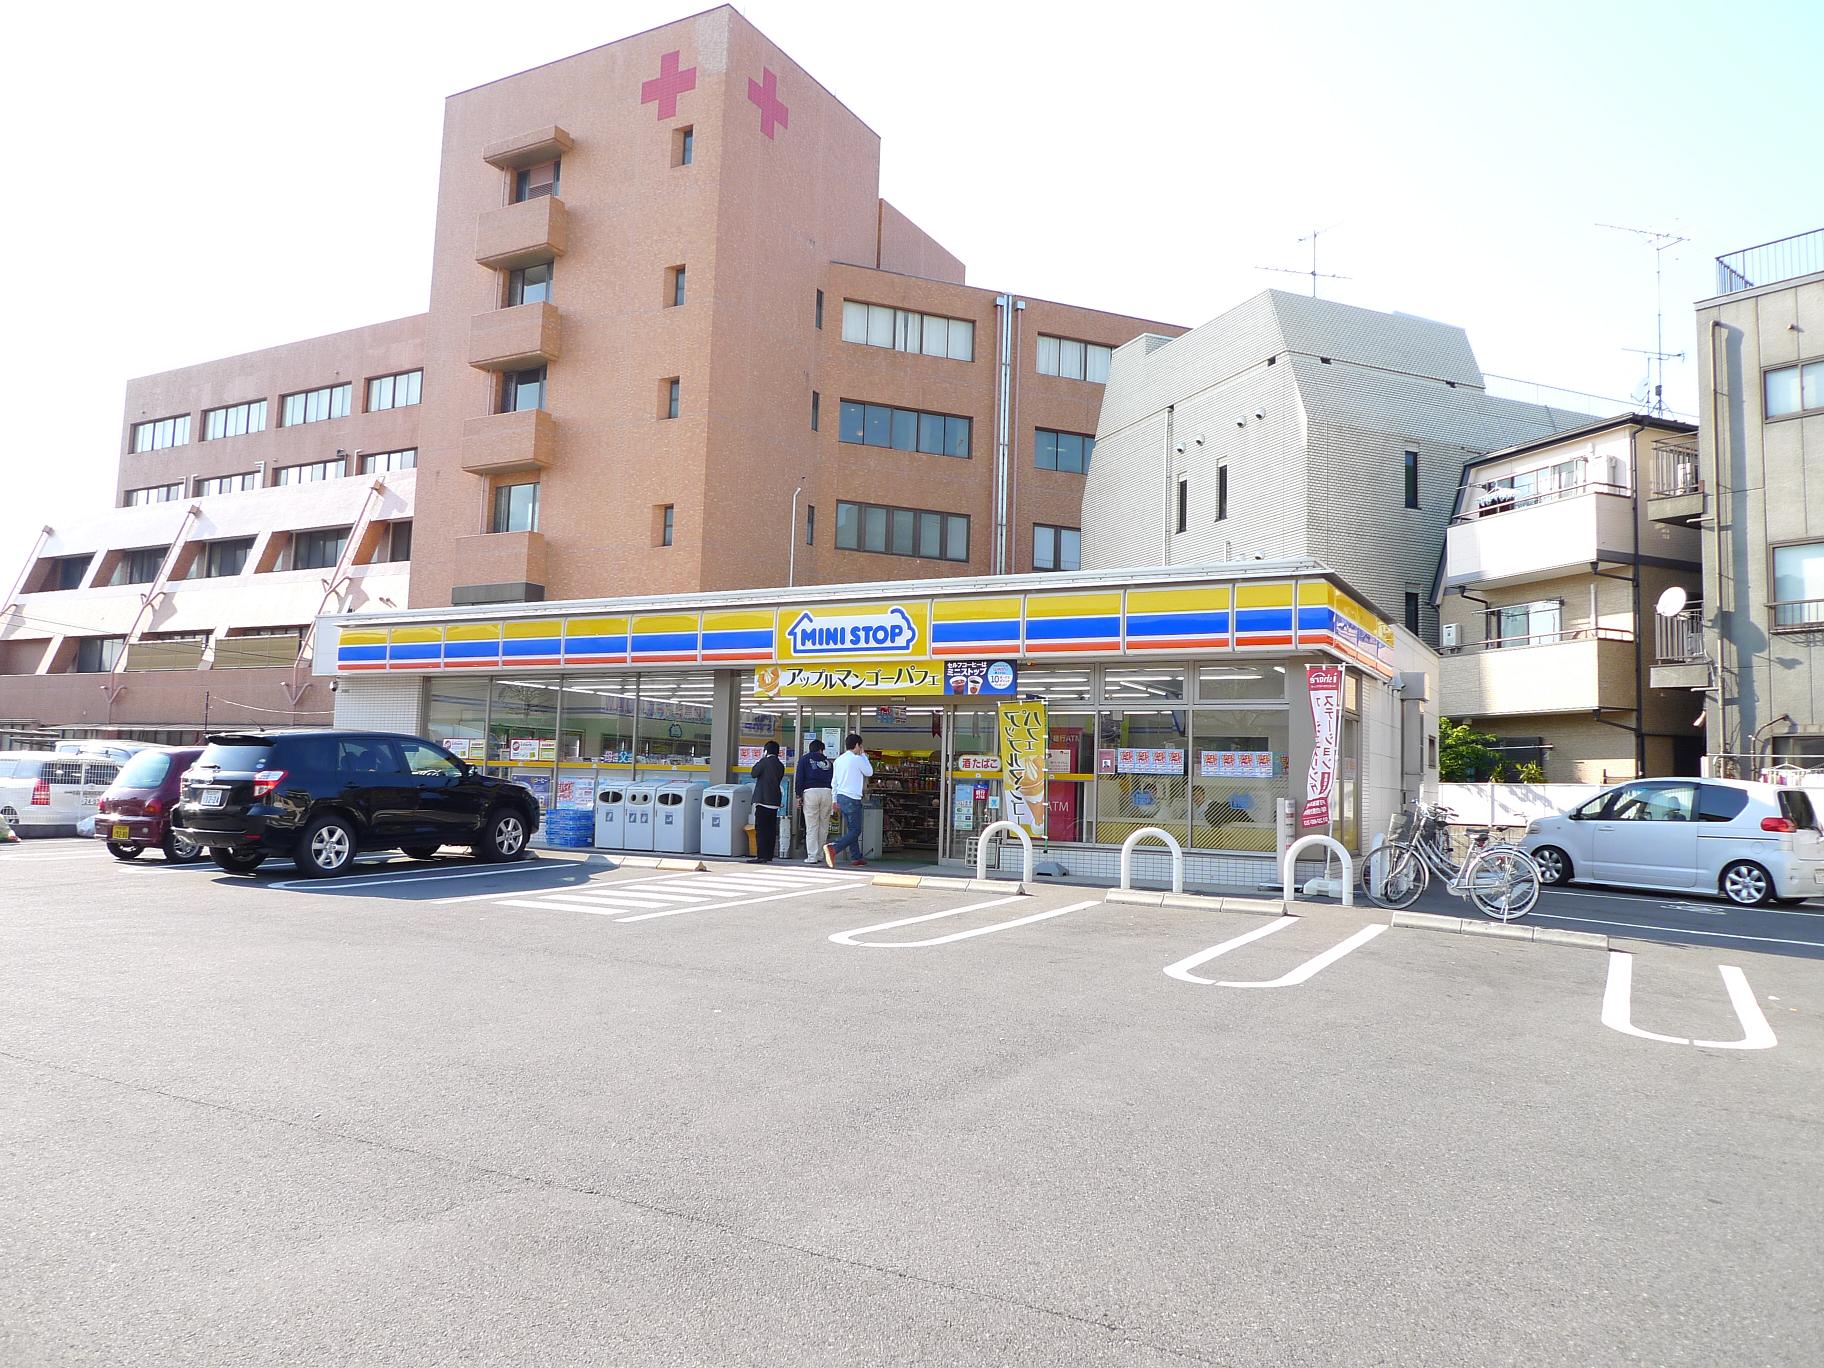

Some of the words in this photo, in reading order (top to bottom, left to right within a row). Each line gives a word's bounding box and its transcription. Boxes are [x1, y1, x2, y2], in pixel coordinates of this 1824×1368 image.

[800, 626, 846, 647] MINI
[849, 624, 904, 646] STOP
[946, 667, 988, 677] ミニストップ
[947, 661, 987, 669] セルフコーヒーは
[786, 664, 940, 690] アップルマンゴーパフェ
